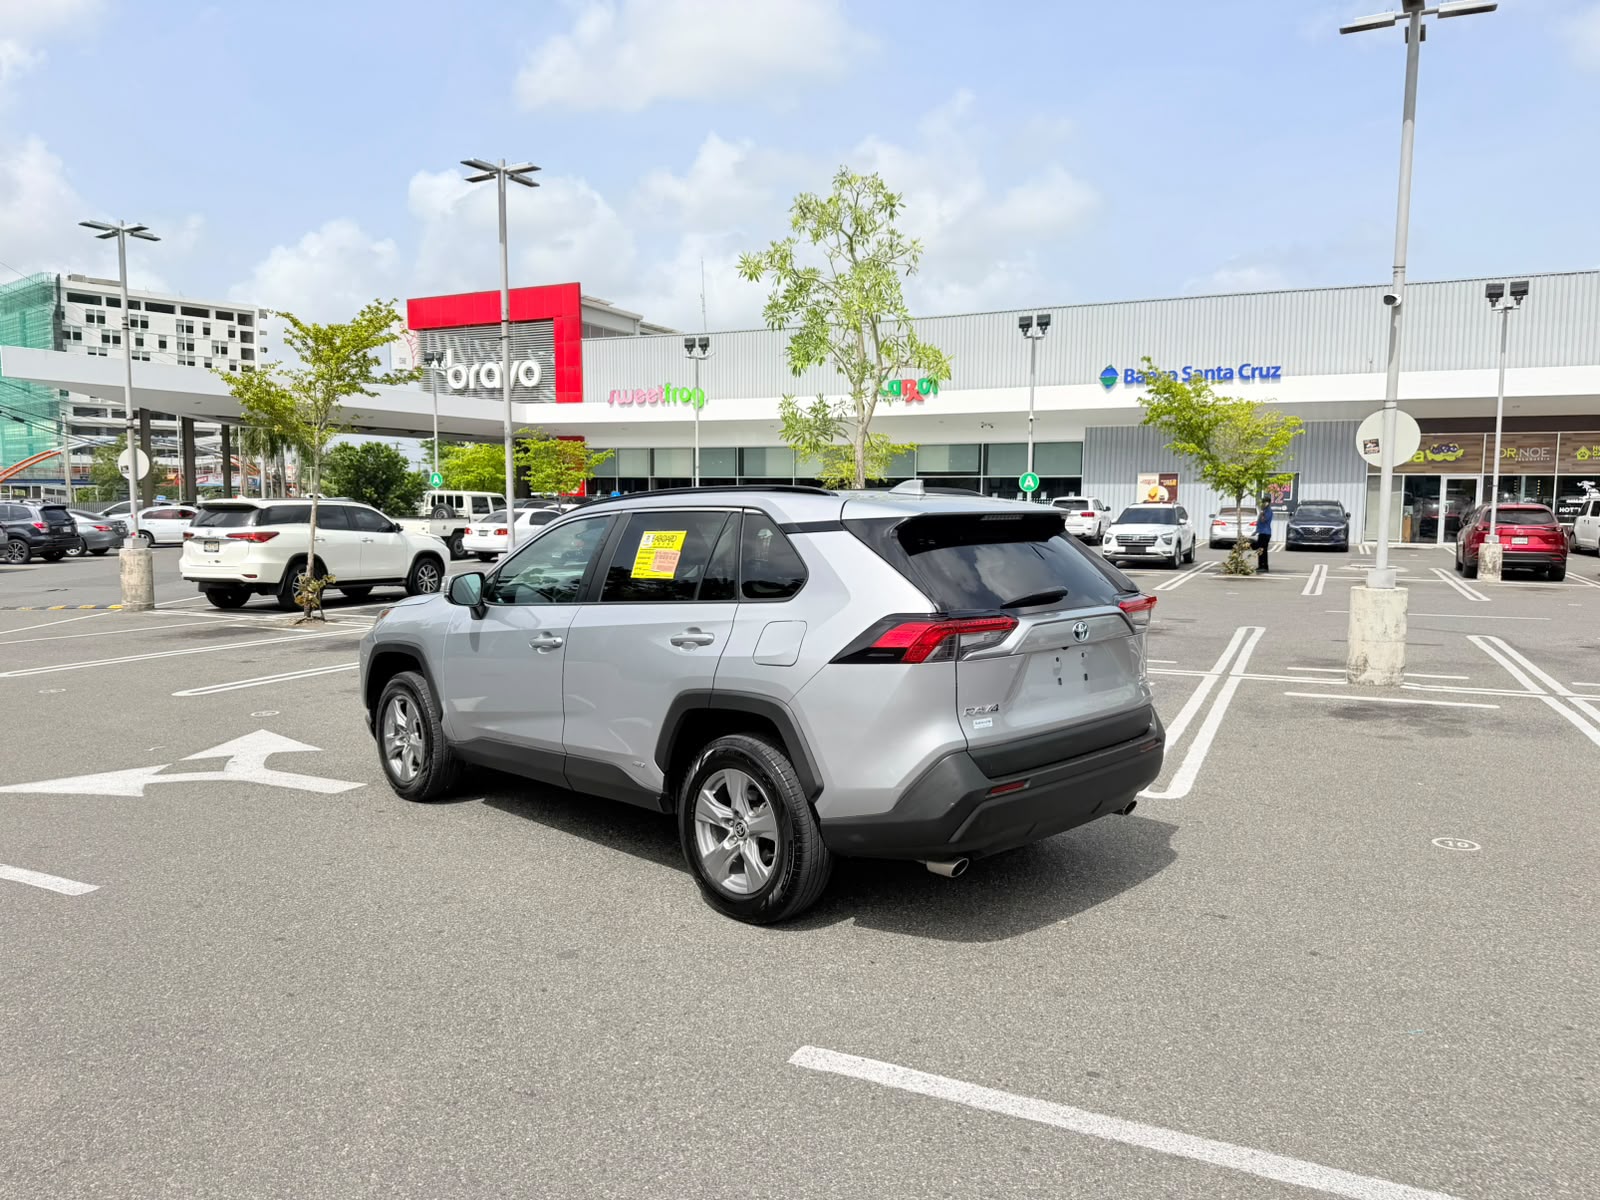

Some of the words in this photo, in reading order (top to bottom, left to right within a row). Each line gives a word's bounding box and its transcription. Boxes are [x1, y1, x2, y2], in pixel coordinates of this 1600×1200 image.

[446, 348, 542, 389] bravo
[1124, 368, 1178, 385] Bao
[1238, 363, 1281, 381] Cruz
[608, 382, 705, 409] sweetfrog
[1023, 475, 1035, 488] A
